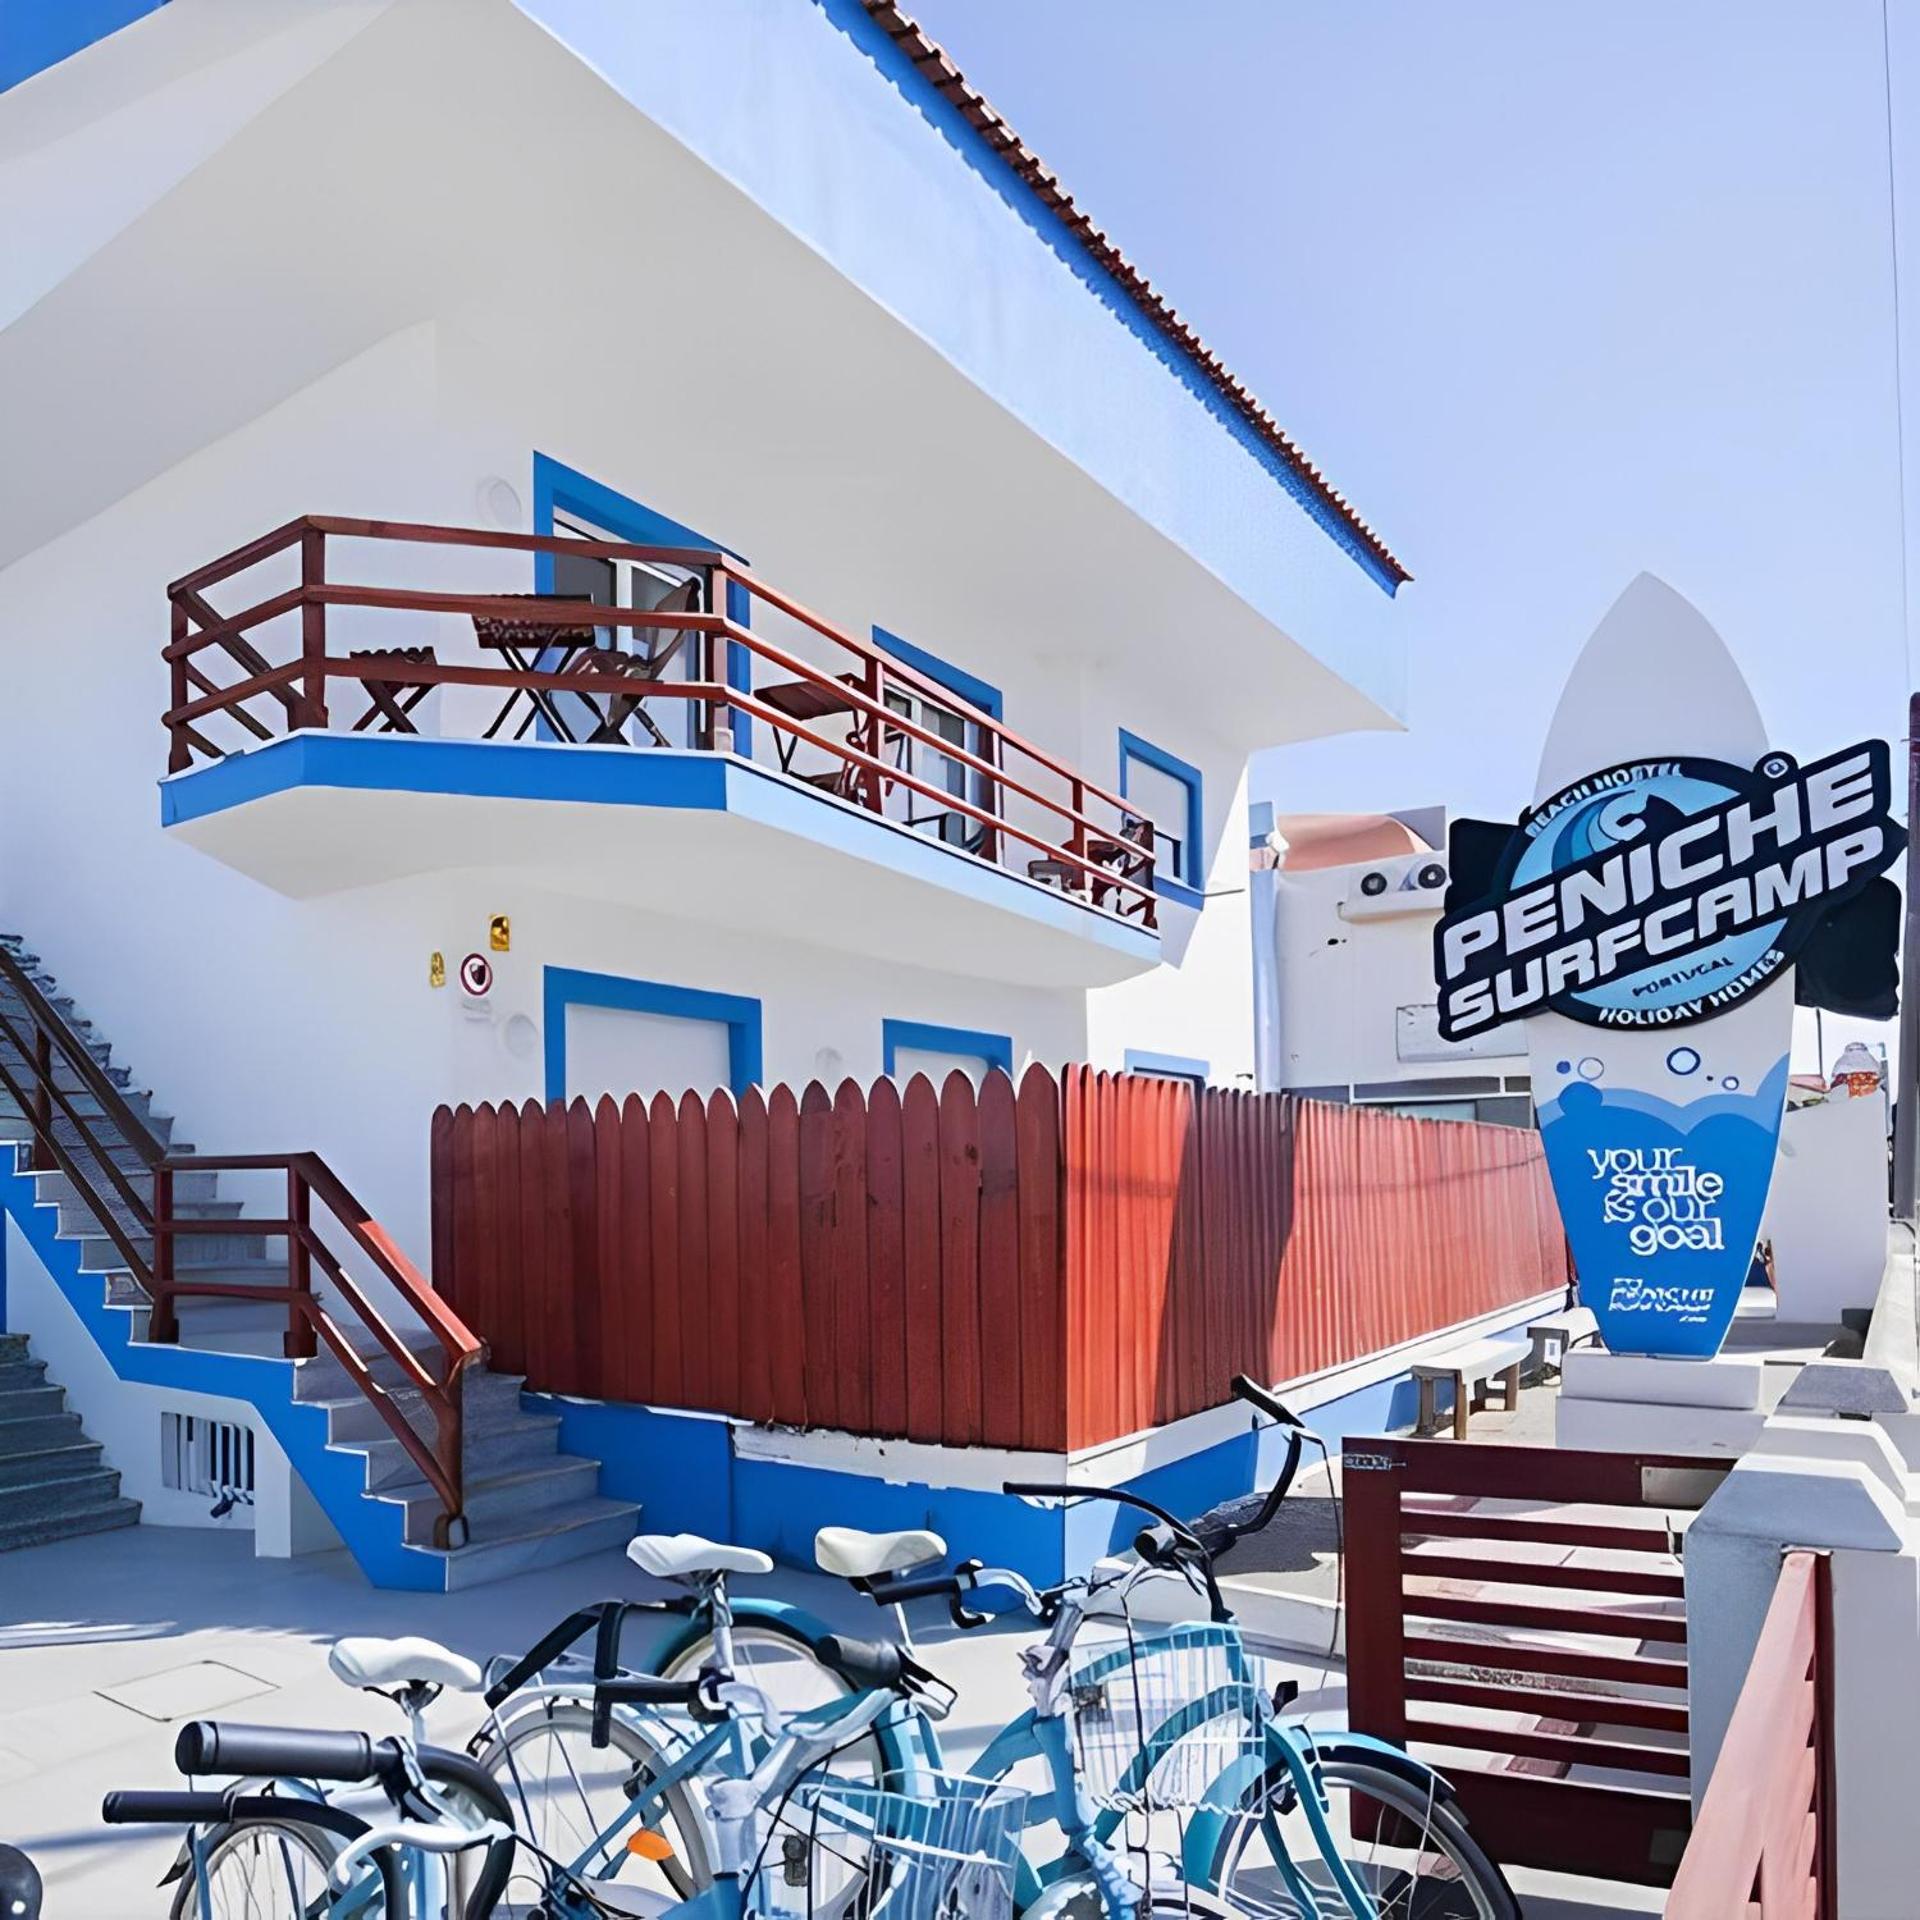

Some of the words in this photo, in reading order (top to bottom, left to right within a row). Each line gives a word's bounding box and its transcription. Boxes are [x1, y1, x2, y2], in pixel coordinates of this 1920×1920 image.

[1443, 752, 1876, 980] PENICHE
[1450, 826, 1884, 1033] SURFCAMP
[1599, 1000, 1703, 1024] HOLIDAY
[1587, 1148, 1682, 1179] your
[1611, 1166, 1723, 1198] smile
[1642, 1196, 1716, 1222] our
[1630, 1217, 1725, 1256] goal
